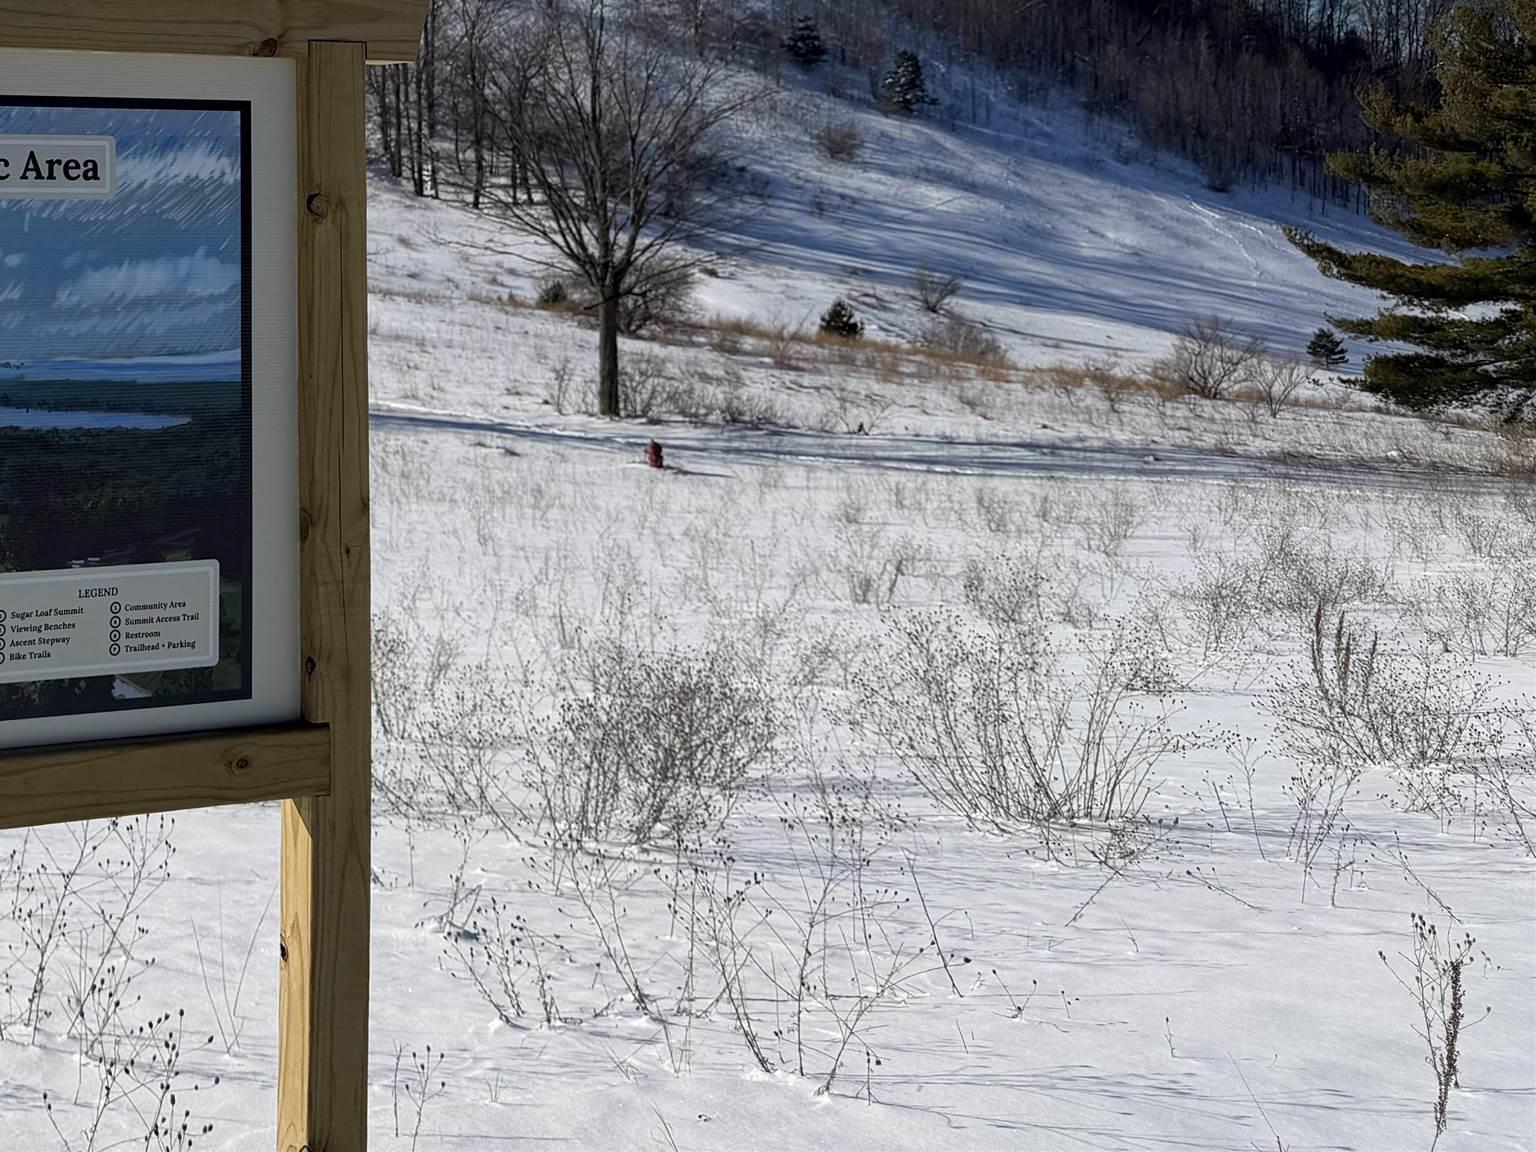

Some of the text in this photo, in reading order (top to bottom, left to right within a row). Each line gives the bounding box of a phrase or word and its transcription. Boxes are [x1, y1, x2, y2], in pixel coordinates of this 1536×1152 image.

[19, 150, 101, 181] Area
[78, 587, 119, 599] LEGEND
[124, 601, 168, 611] Community
[169, 601, 186, 609] Area
[10, 611, 34, 621] Sugar
[35, 608, 53, 617] Loaf
[53, 607, 84, 616] Summit
[125, 616, 154, 626] Summit
[155, 615, 181, 624] Access
[181, 612, 200, 622] Trail
[10, 624, 42, 634] Viewing
[43, 622, 76, 631] Benches
[125, 631, 161, 640] Restroom
[9, 639, 36, 647] Ascent
[37, 637, 71, 646] Stepway
[124, 642, 160, 653] Trailhead
[167, 640, 196, 650] Parking
[9, 652, 26, 661] Bike
[27, 650, 52, 659] Trails
